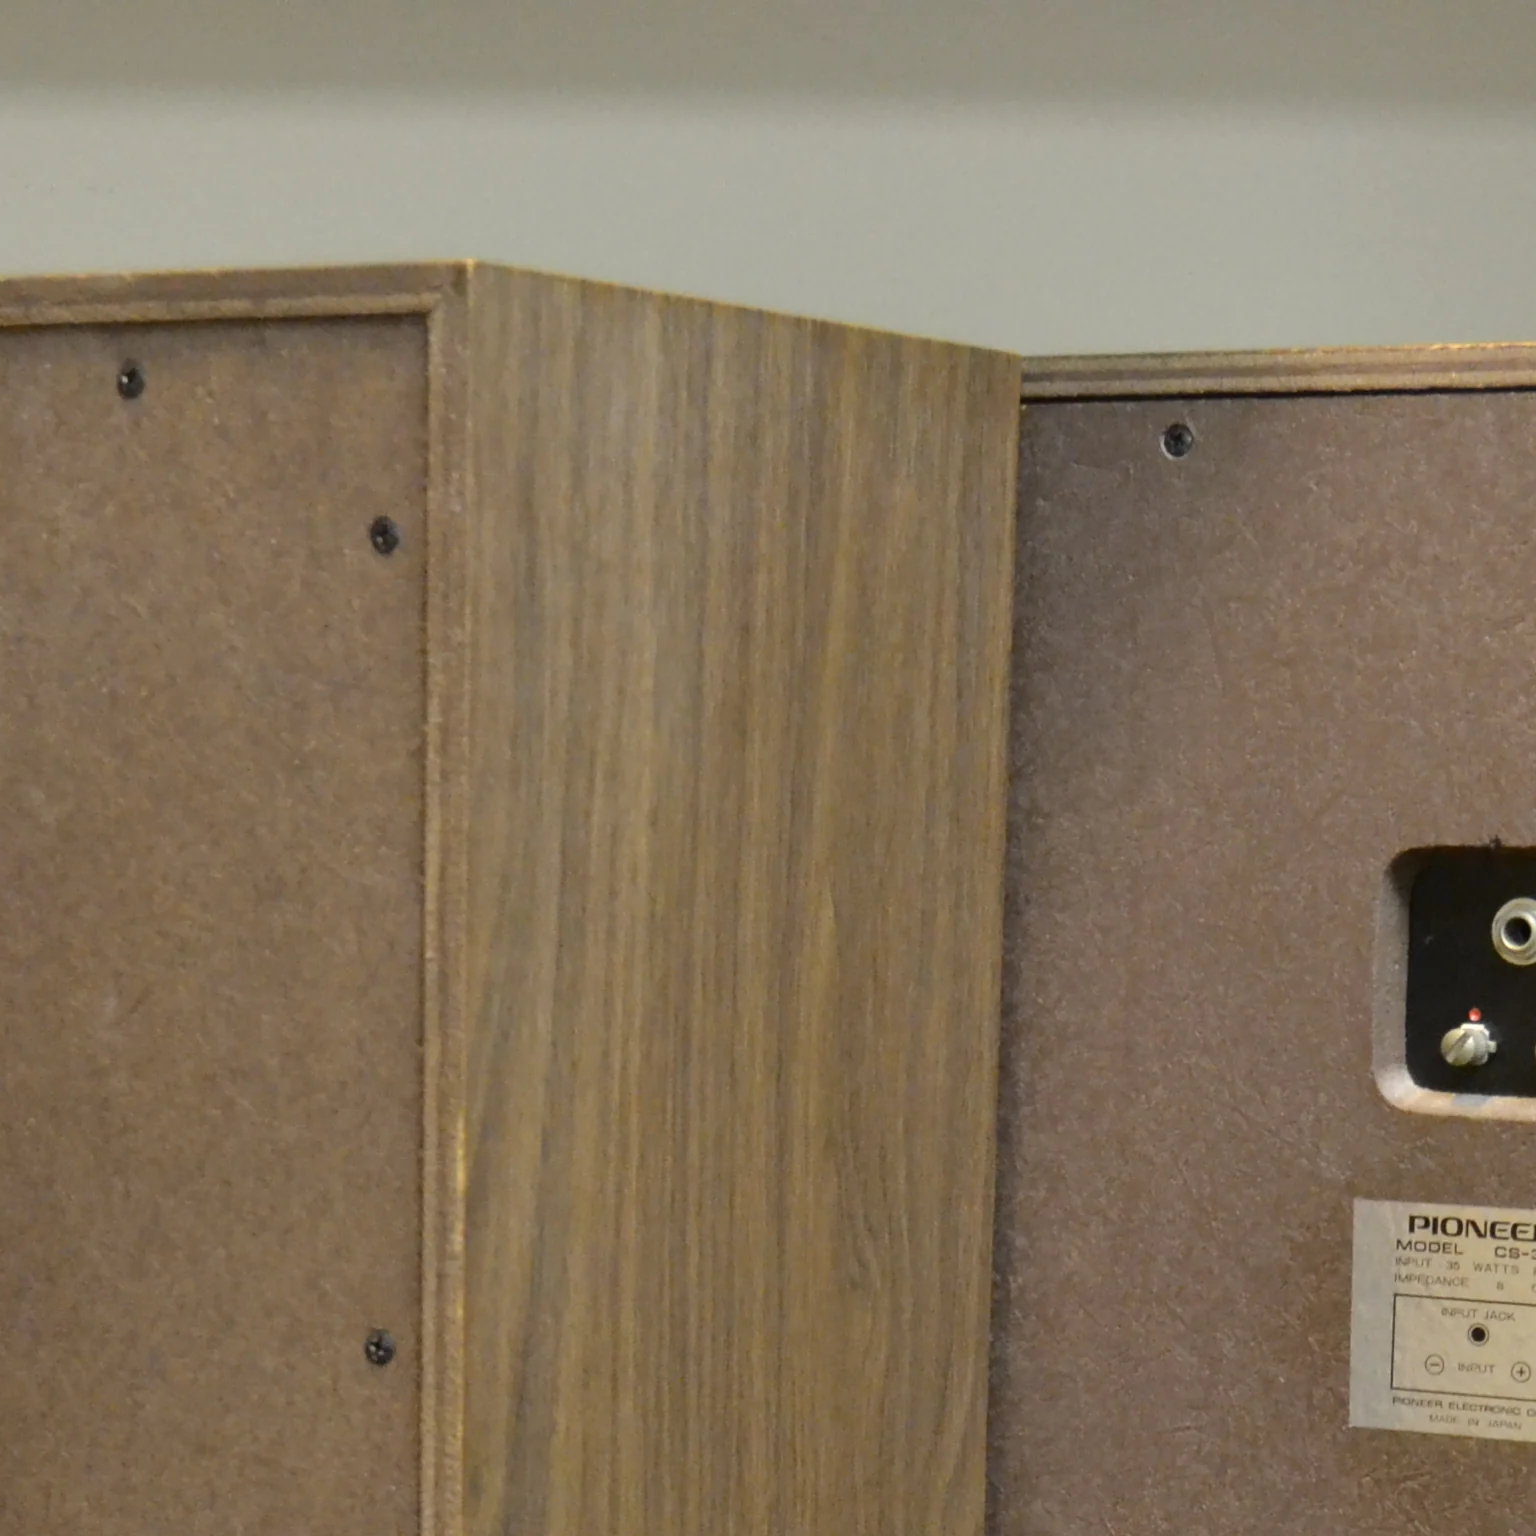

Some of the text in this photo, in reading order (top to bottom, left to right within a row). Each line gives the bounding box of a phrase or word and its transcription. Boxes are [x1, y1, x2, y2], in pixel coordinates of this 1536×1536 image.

[1395, 1238, 1464, 1256] MODEL
[1395, 1256, 1432, 1268] INPUT
[1472, 1262, 1520, 1275] WATTS
[1394, 1273, 1470, 1288] IMPEDANCE
[1441, 1307, 1516, 1322] INPUT JACK
[1457, 1362, 1496, 1375] INPUT
[1392, 1396, 1444, 1409] PIONEER
[1448, 1401, 1521, 1416] ELECTRONIC
[1429, 1414, 1459, 1424] MADE
[1488, 1420, 1523, 1431] JAPAN
